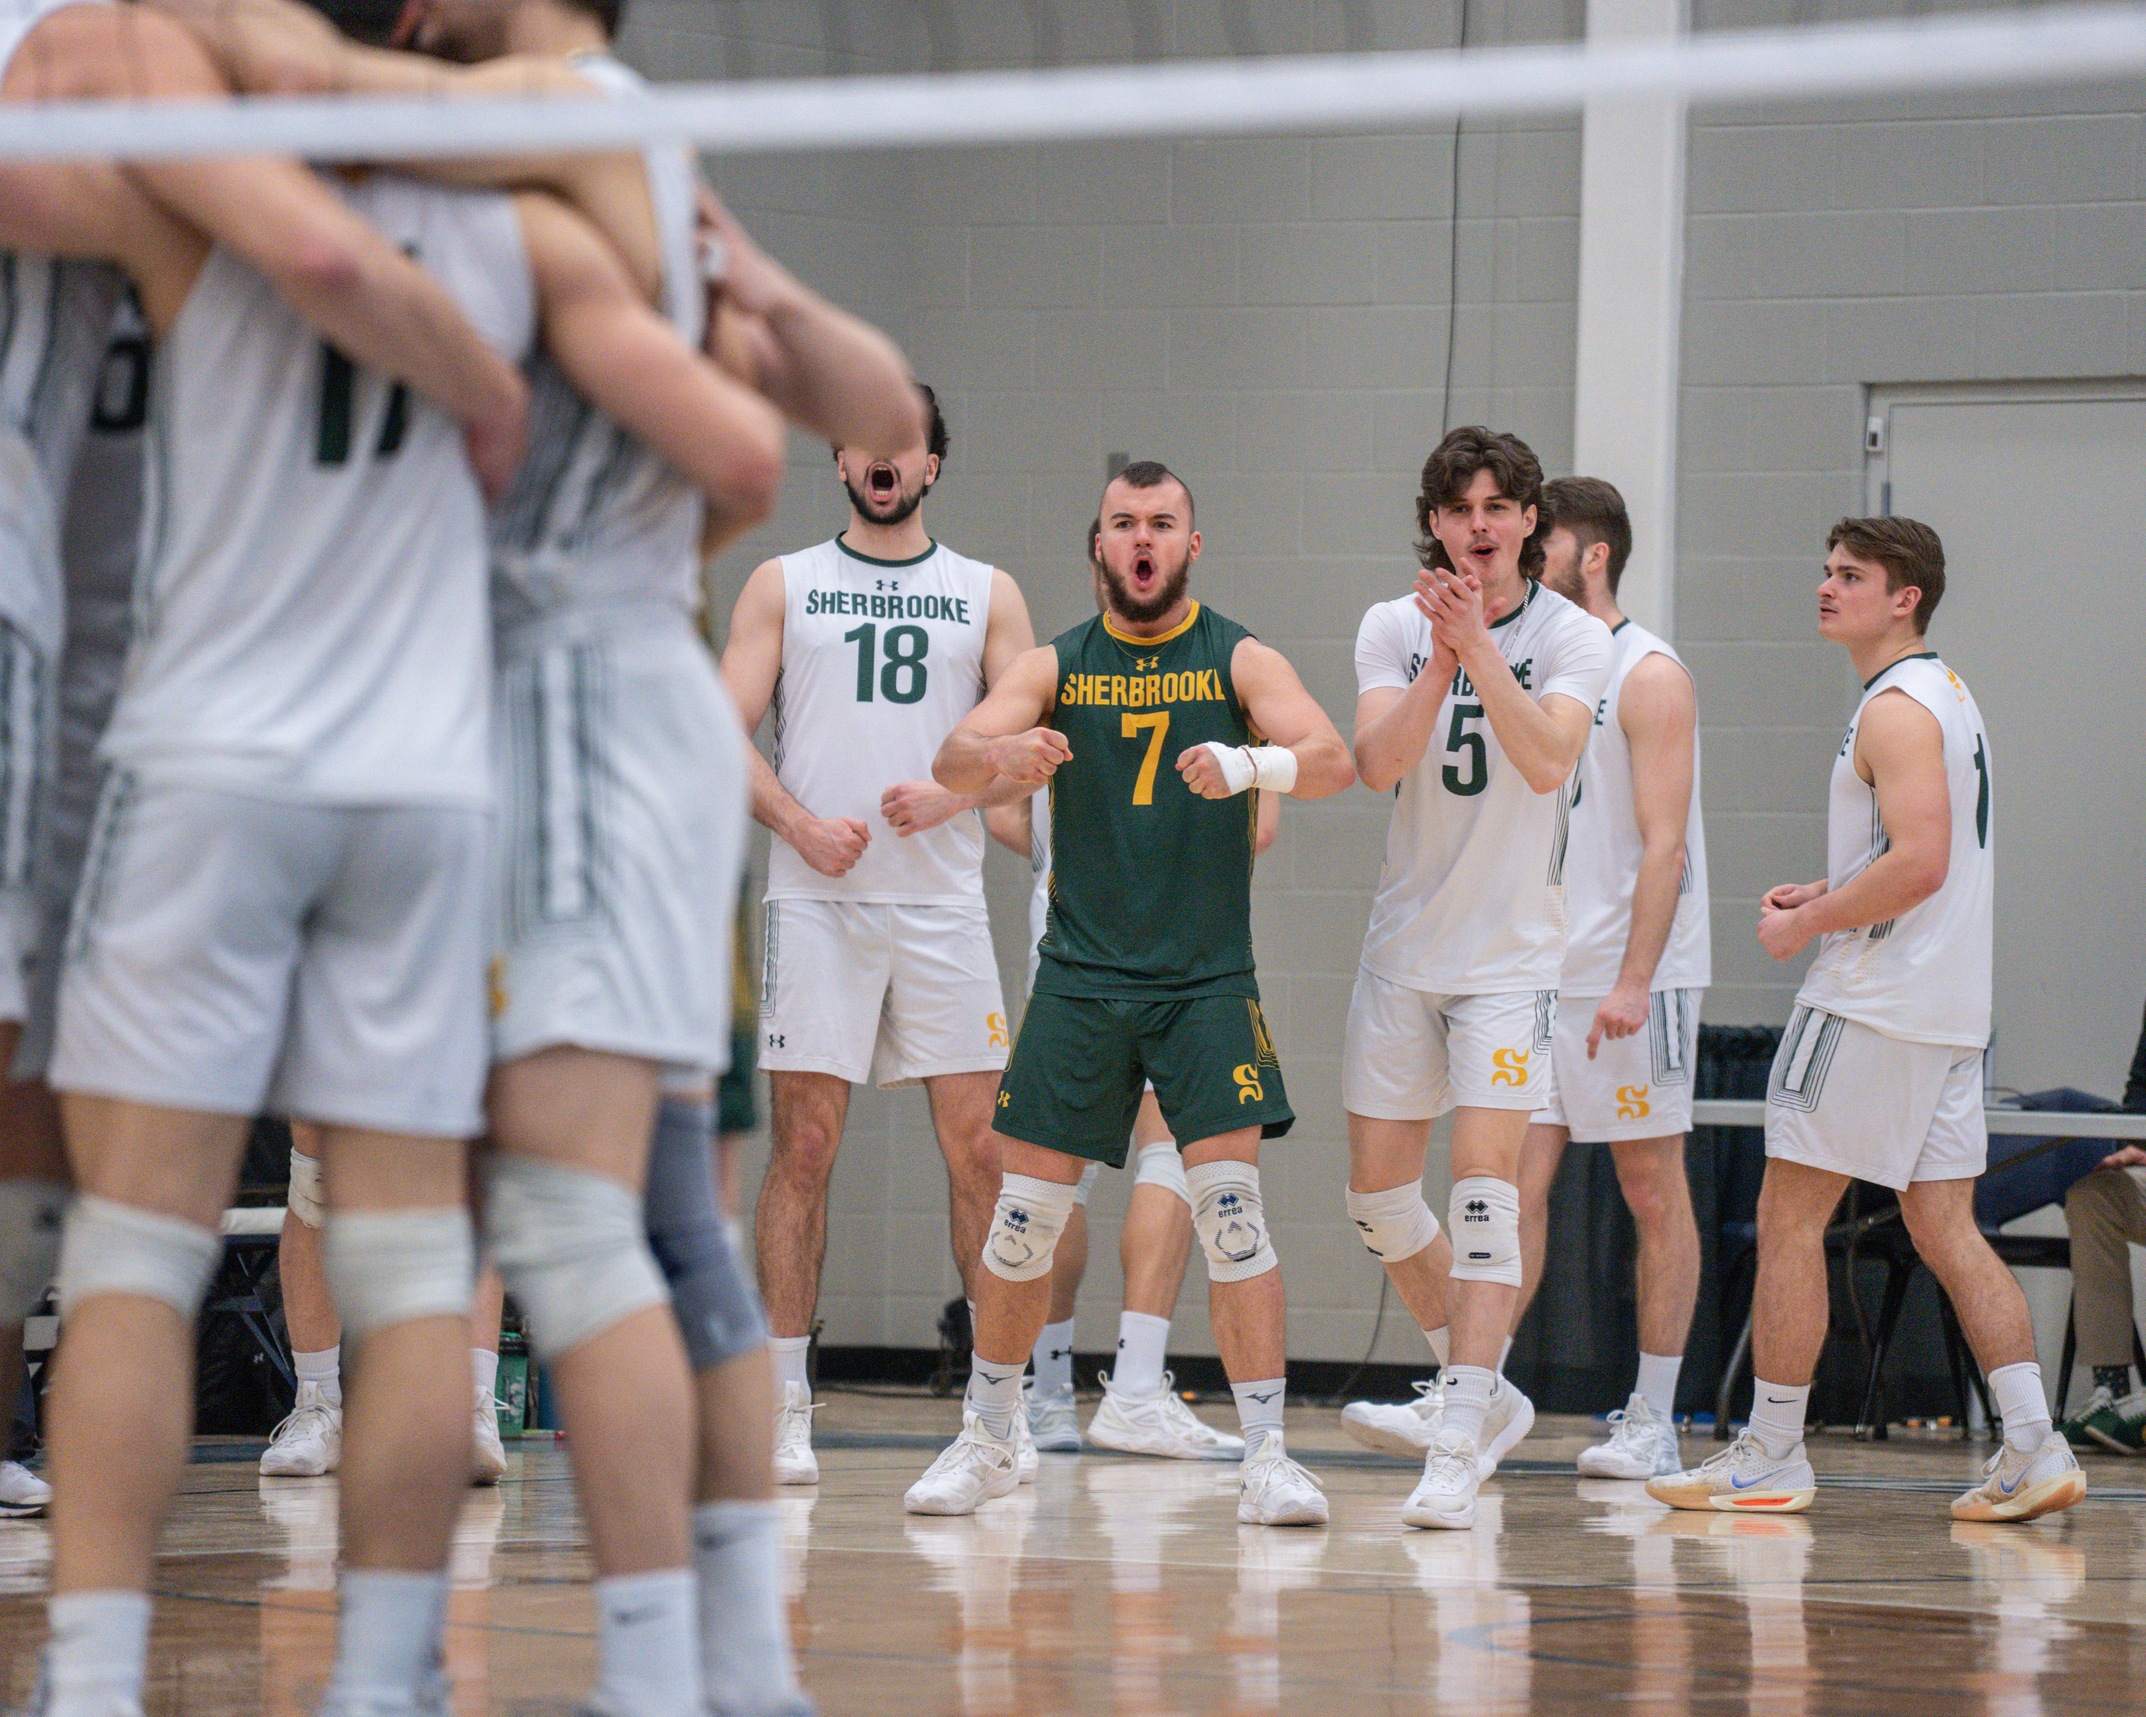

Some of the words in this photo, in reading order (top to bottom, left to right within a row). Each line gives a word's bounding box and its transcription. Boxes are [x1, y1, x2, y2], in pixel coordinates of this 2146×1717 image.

[806, 588, 971, 626] SHERBROOKE
[843, 622, 929, 705] 18
[1121, 710, 1170, 806] 7
[1442, 703, 1488, 796] 5
[1004, 1219, 1026, 1234] errea
[1218, 1205, 1243, 1218] errea
[1464, 1214, 1490, 1222] errea
